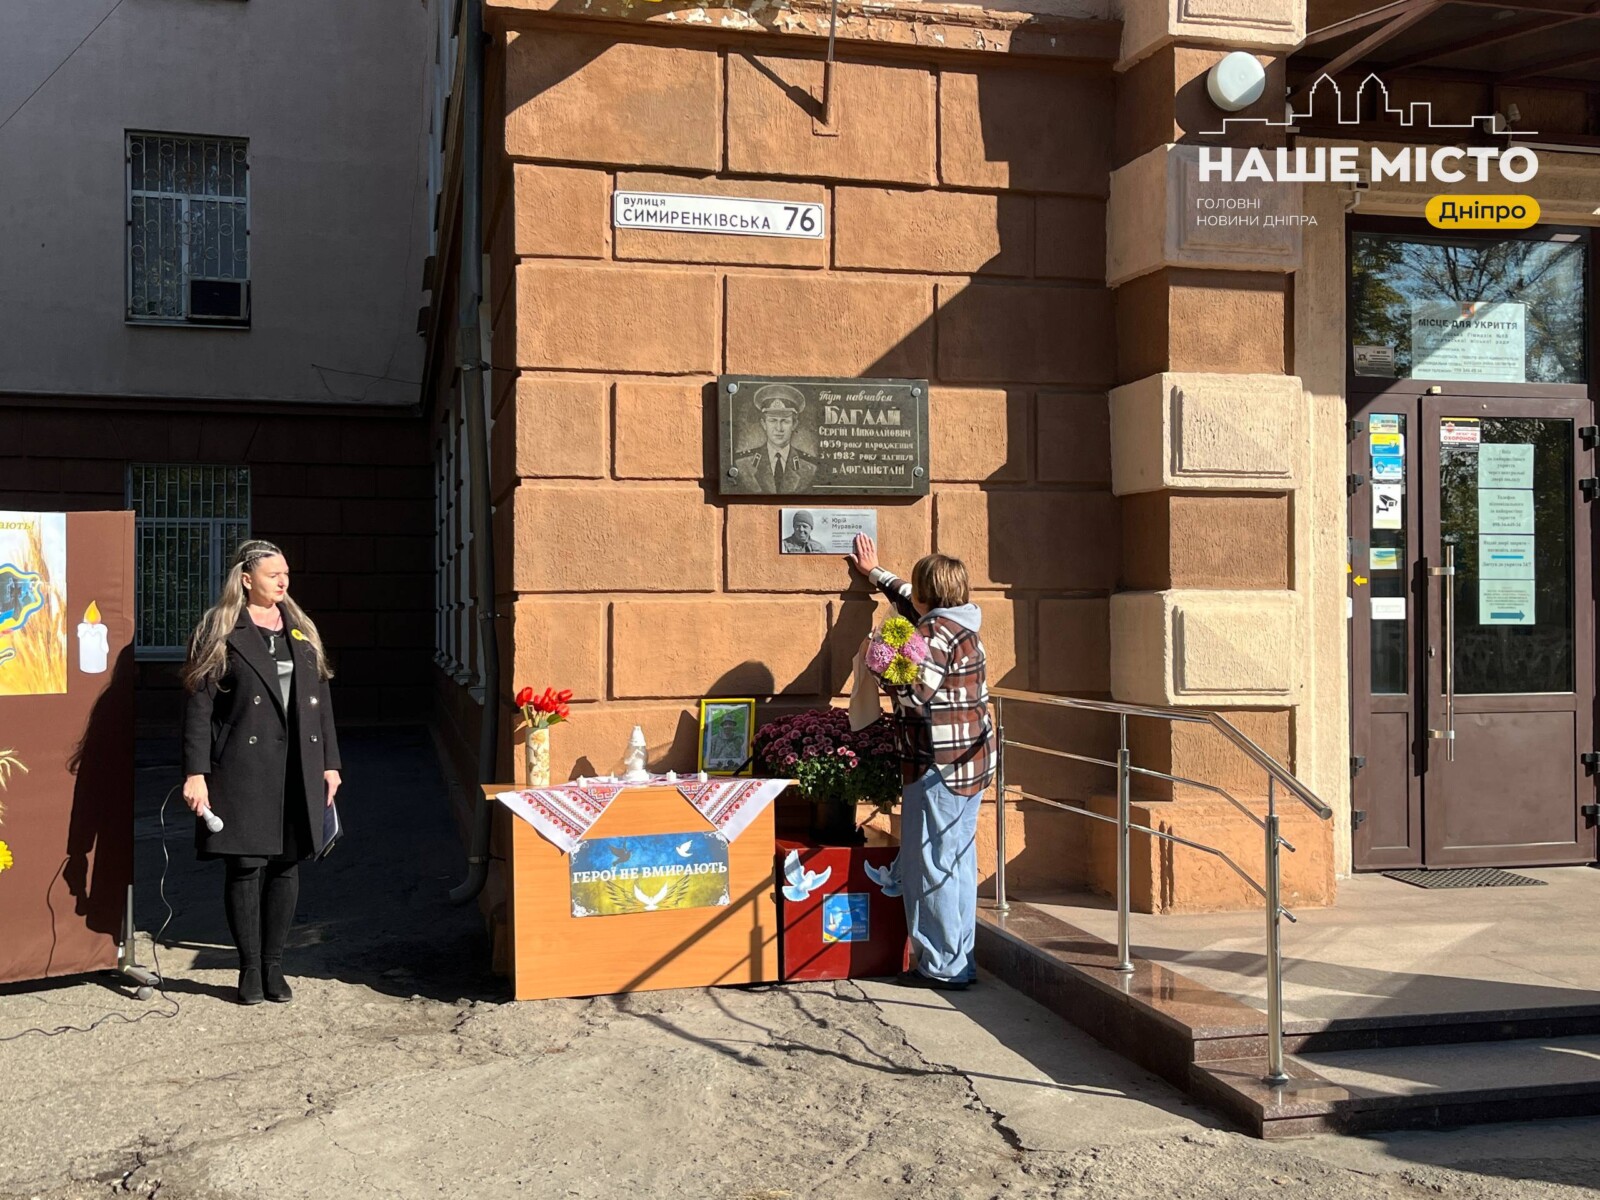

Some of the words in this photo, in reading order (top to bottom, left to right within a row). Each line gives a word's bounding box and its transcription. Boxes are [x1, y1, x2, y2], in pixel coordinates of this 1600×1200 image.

[623, 196, 666, 207] вулиця
[622, 208, 771, 230] СИМИРЕНКІВСЬКА
[783, 206, 815, 232] 76
[1418, 319, 1449, 329] МІСЦЕ
[1451, 320, 1472, 329] ДЛЯ
[1474, 321, 1518, 330] УКРИТТЯ
[824, 405, 900, 426] БАГЛАЙ
[833, 451, 856, 460] 1982
[572, 866, 618, 884] ГЕРОЇ
[619, 866, 639, 880] НЕ
[641, 861, 728, 879] ВМИРАЮТЬ
